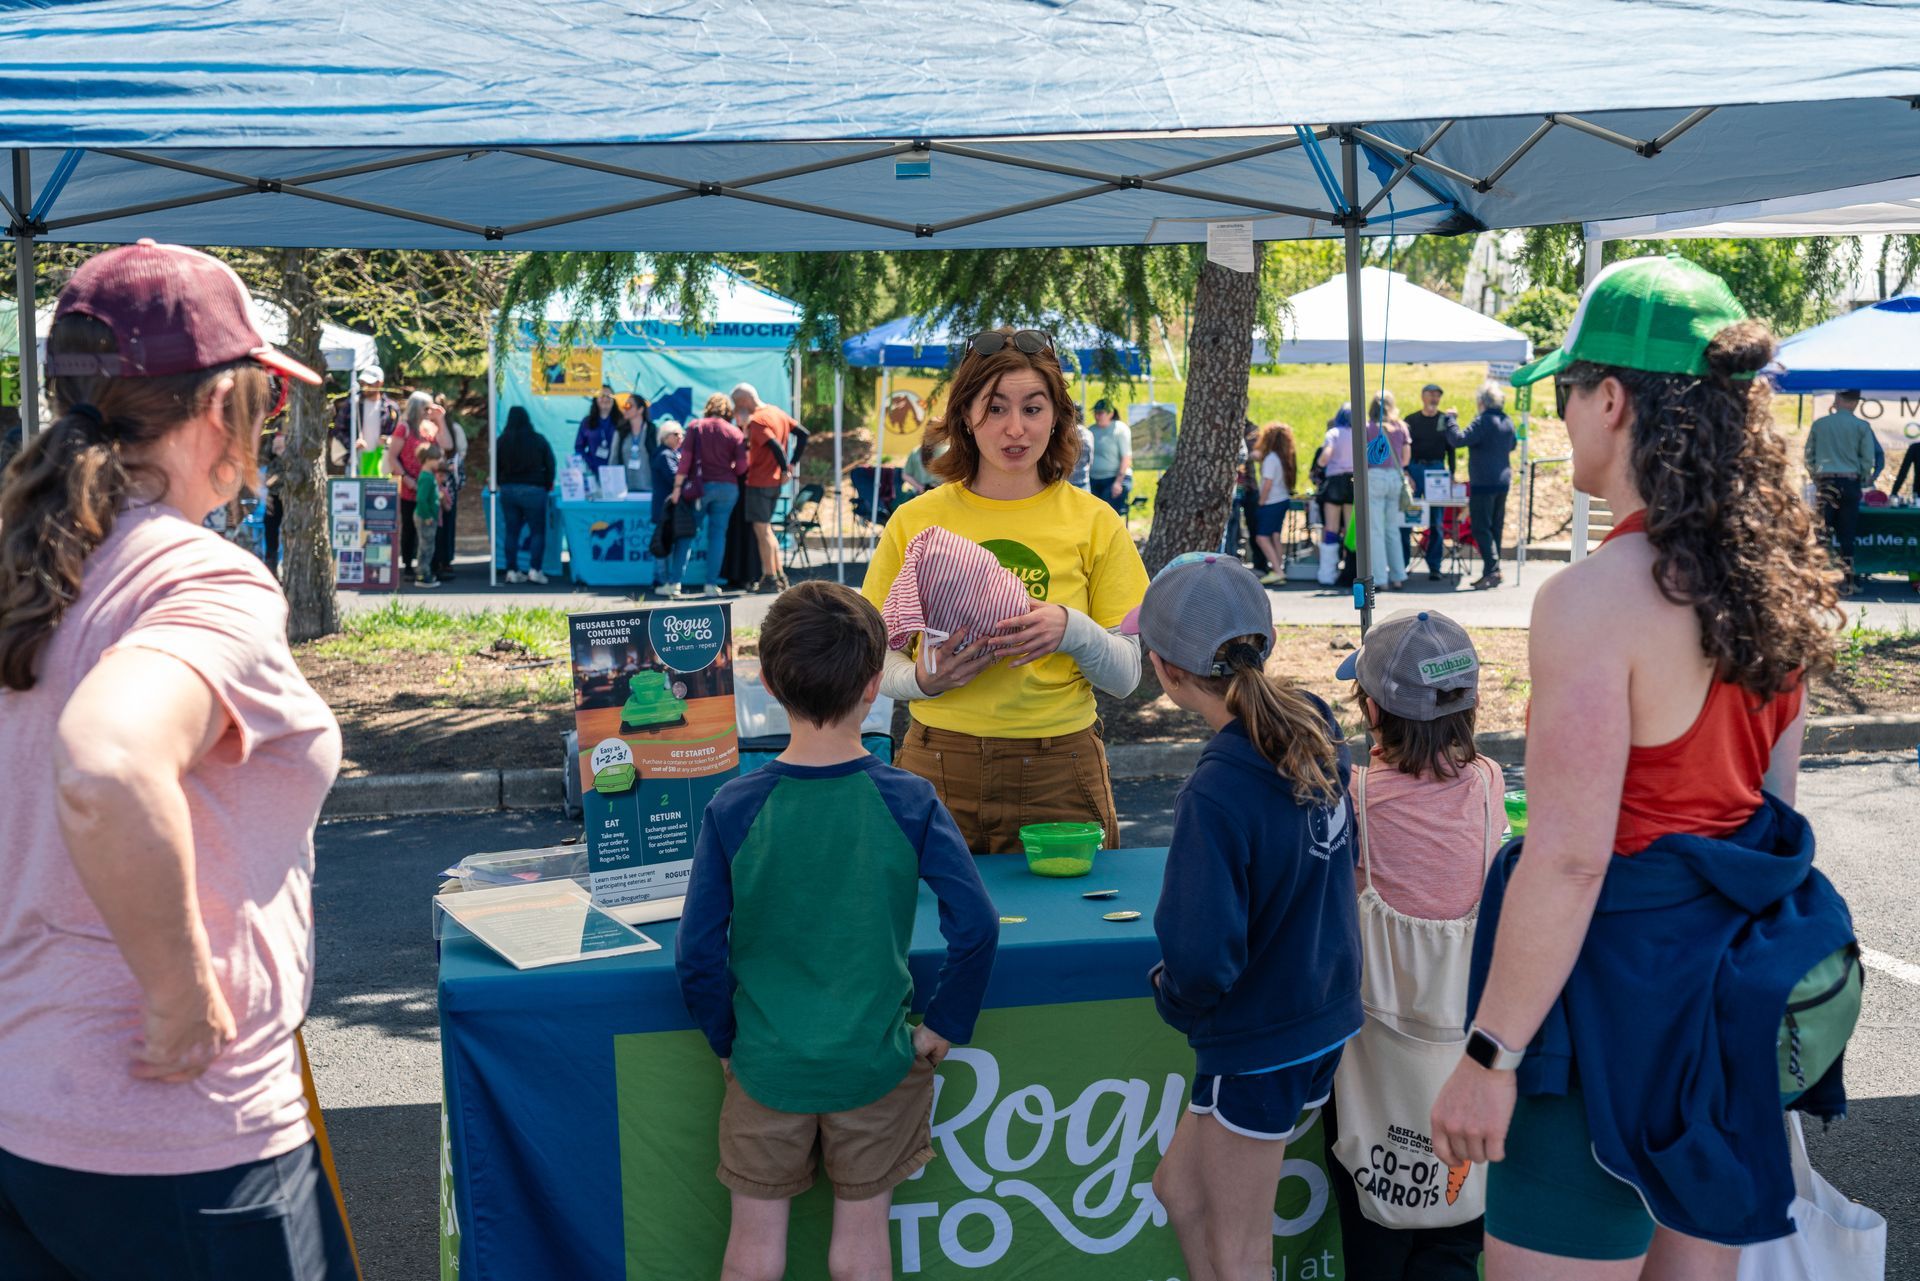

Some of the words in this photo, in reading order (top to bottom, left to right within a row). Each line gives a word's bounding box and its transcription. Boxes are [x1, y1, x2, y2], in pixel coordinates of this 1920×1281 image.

[1877, 535, 1904, 546] Me
[1907, 537, 1918, 545] a
[576, 619, 615, 630] REUSABLE
[616, 618, 641, 628] TO-GO
[663, 615, 712, 637] Rogue
[587, 627, 631, 638] CONTAINER
[664, 633, 680, 643] TO
[695, 629, 713, 641] GO
[590, 636, 629, 646] PROGRAM
[698, 642, 717, 650] repeat
[600, 746, 613, 755] Easy
[671, 750, 685, 758] GET
[685, 746, 716, 757] STARTED
[596, 749, 628, 766] 1-2-3!
[660, 794, 669, 806] 2
[607, 801, 614, 813] 1
[650, 811, 681, 823] RETURN
[605, 819, 620, 828] EAT
[645, 825, 667, 834] Exchange
[663, 831, 687, 839] containers
[610, 839, 623, 847] order
[657, 839, 675, 848] another
[599, 847, 620, 855] leftovers
[638, 870, 656, 878] current
[596, 881, 627, 891] participating
[1387, 1132, 1409, 1145] FOOD
[1371, 1144, 1440, 1186] CO-OP
[1354, 1167, 1440, 1209] CARROTS
[889, 1198, 1013, 1273] TO
